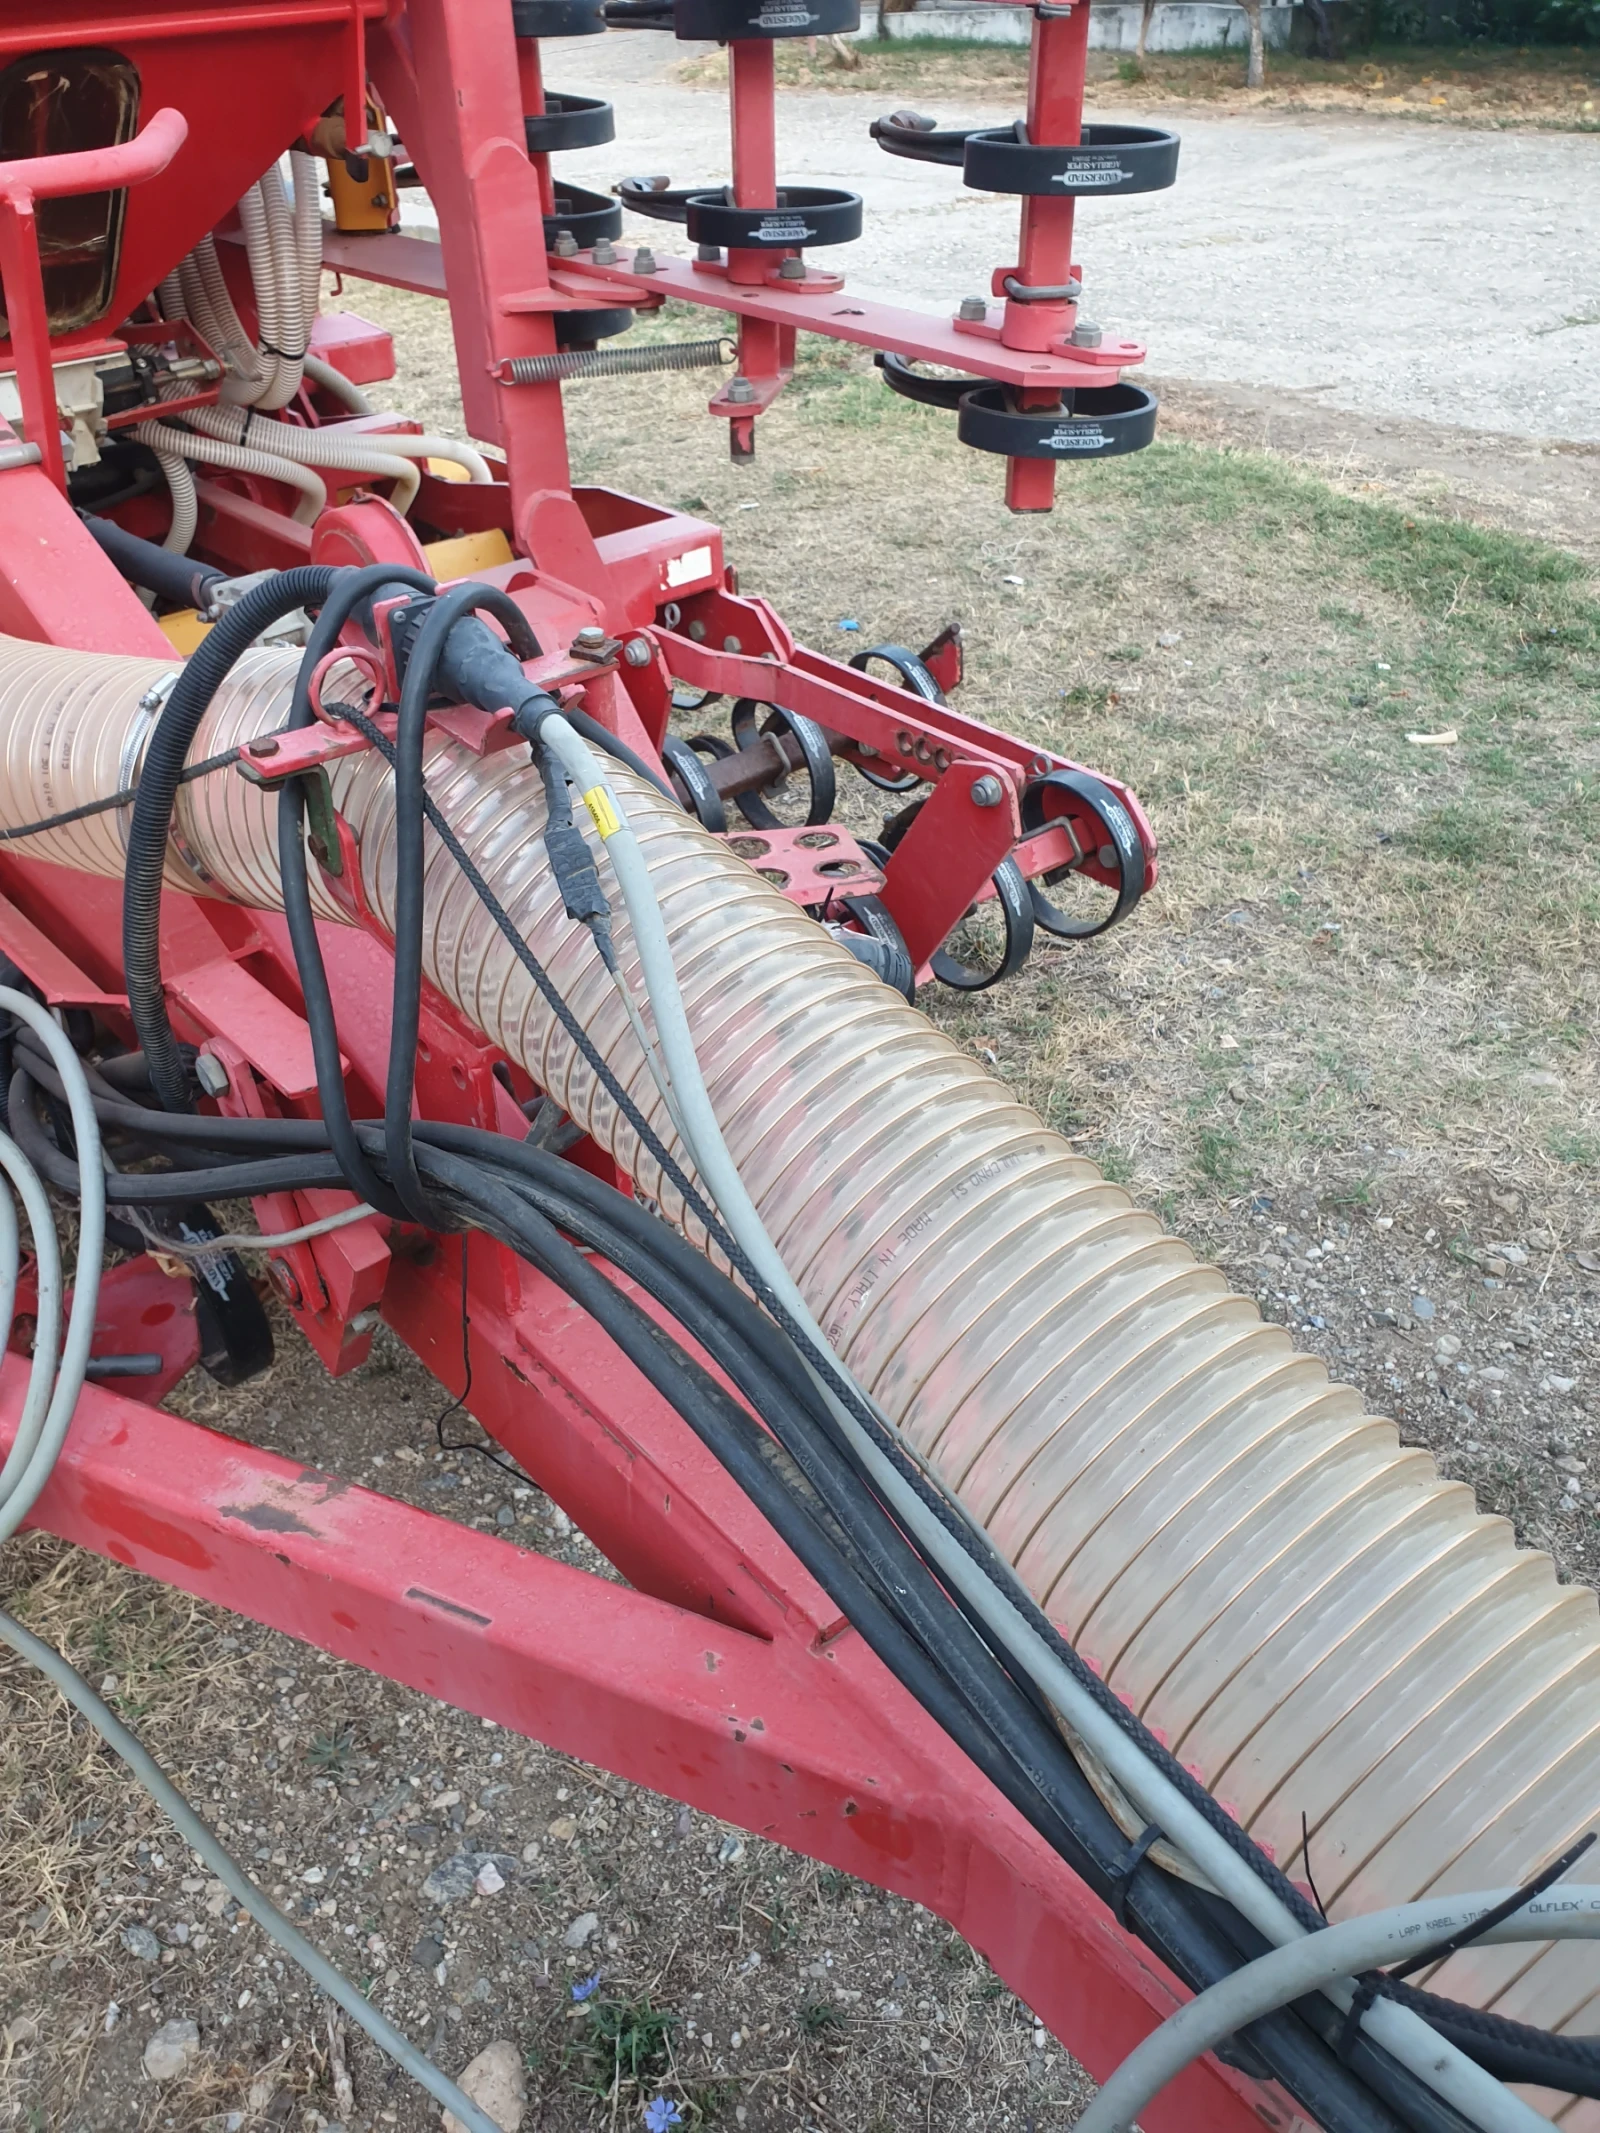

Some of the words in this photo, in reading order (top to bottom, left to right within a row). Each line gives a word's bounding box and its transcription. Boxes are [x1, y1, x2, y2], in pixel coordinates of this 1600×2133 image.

[897, 1211, 933, 1246] MADE
[877, 1247, 898, 1268] IN
[847, 1269, 880, 1310] ITALY
[1426, 1916, 1457, 1931] KABEL
